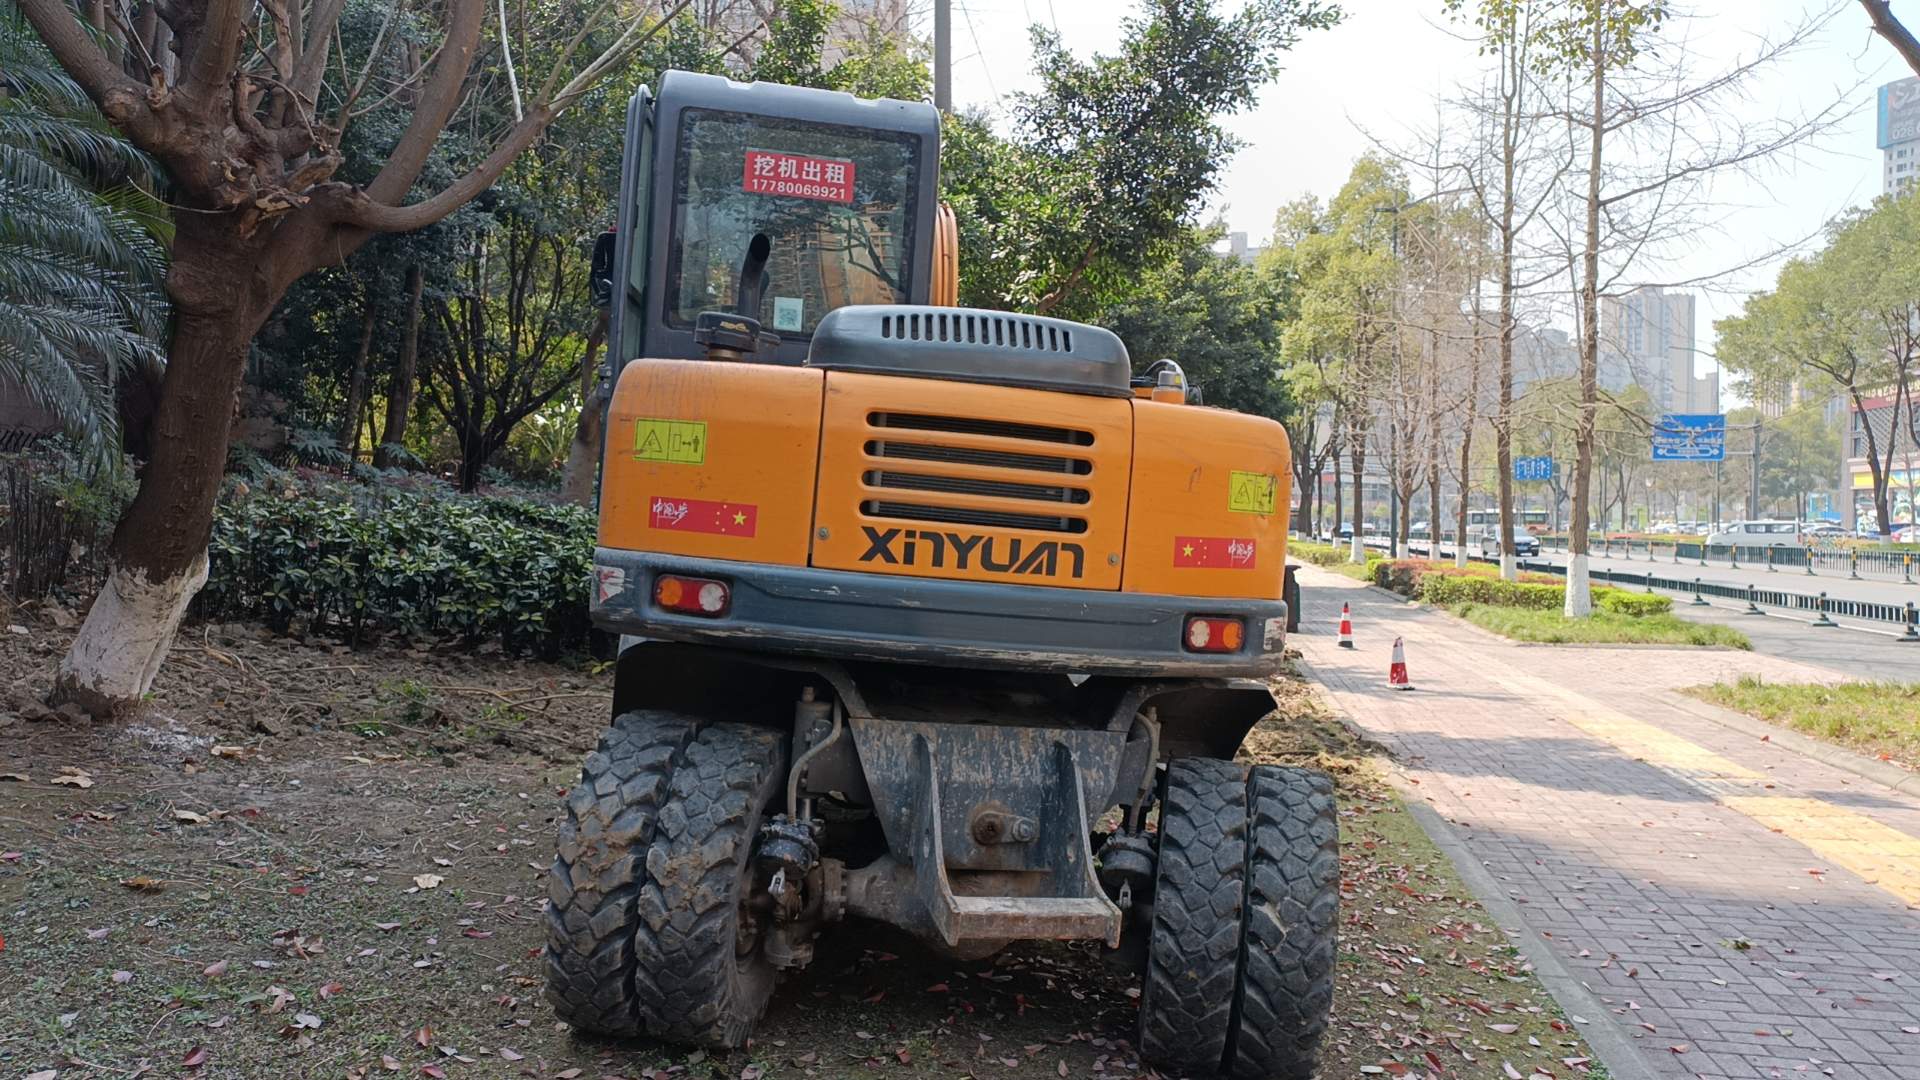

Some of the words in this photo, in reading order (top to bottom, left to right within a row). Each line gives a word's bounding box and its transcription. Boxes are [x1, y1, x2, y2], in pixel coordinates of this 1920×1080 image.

[754, 155, 845, 184] 挖机出租
[752, 179, 845, 199] 17780069921
